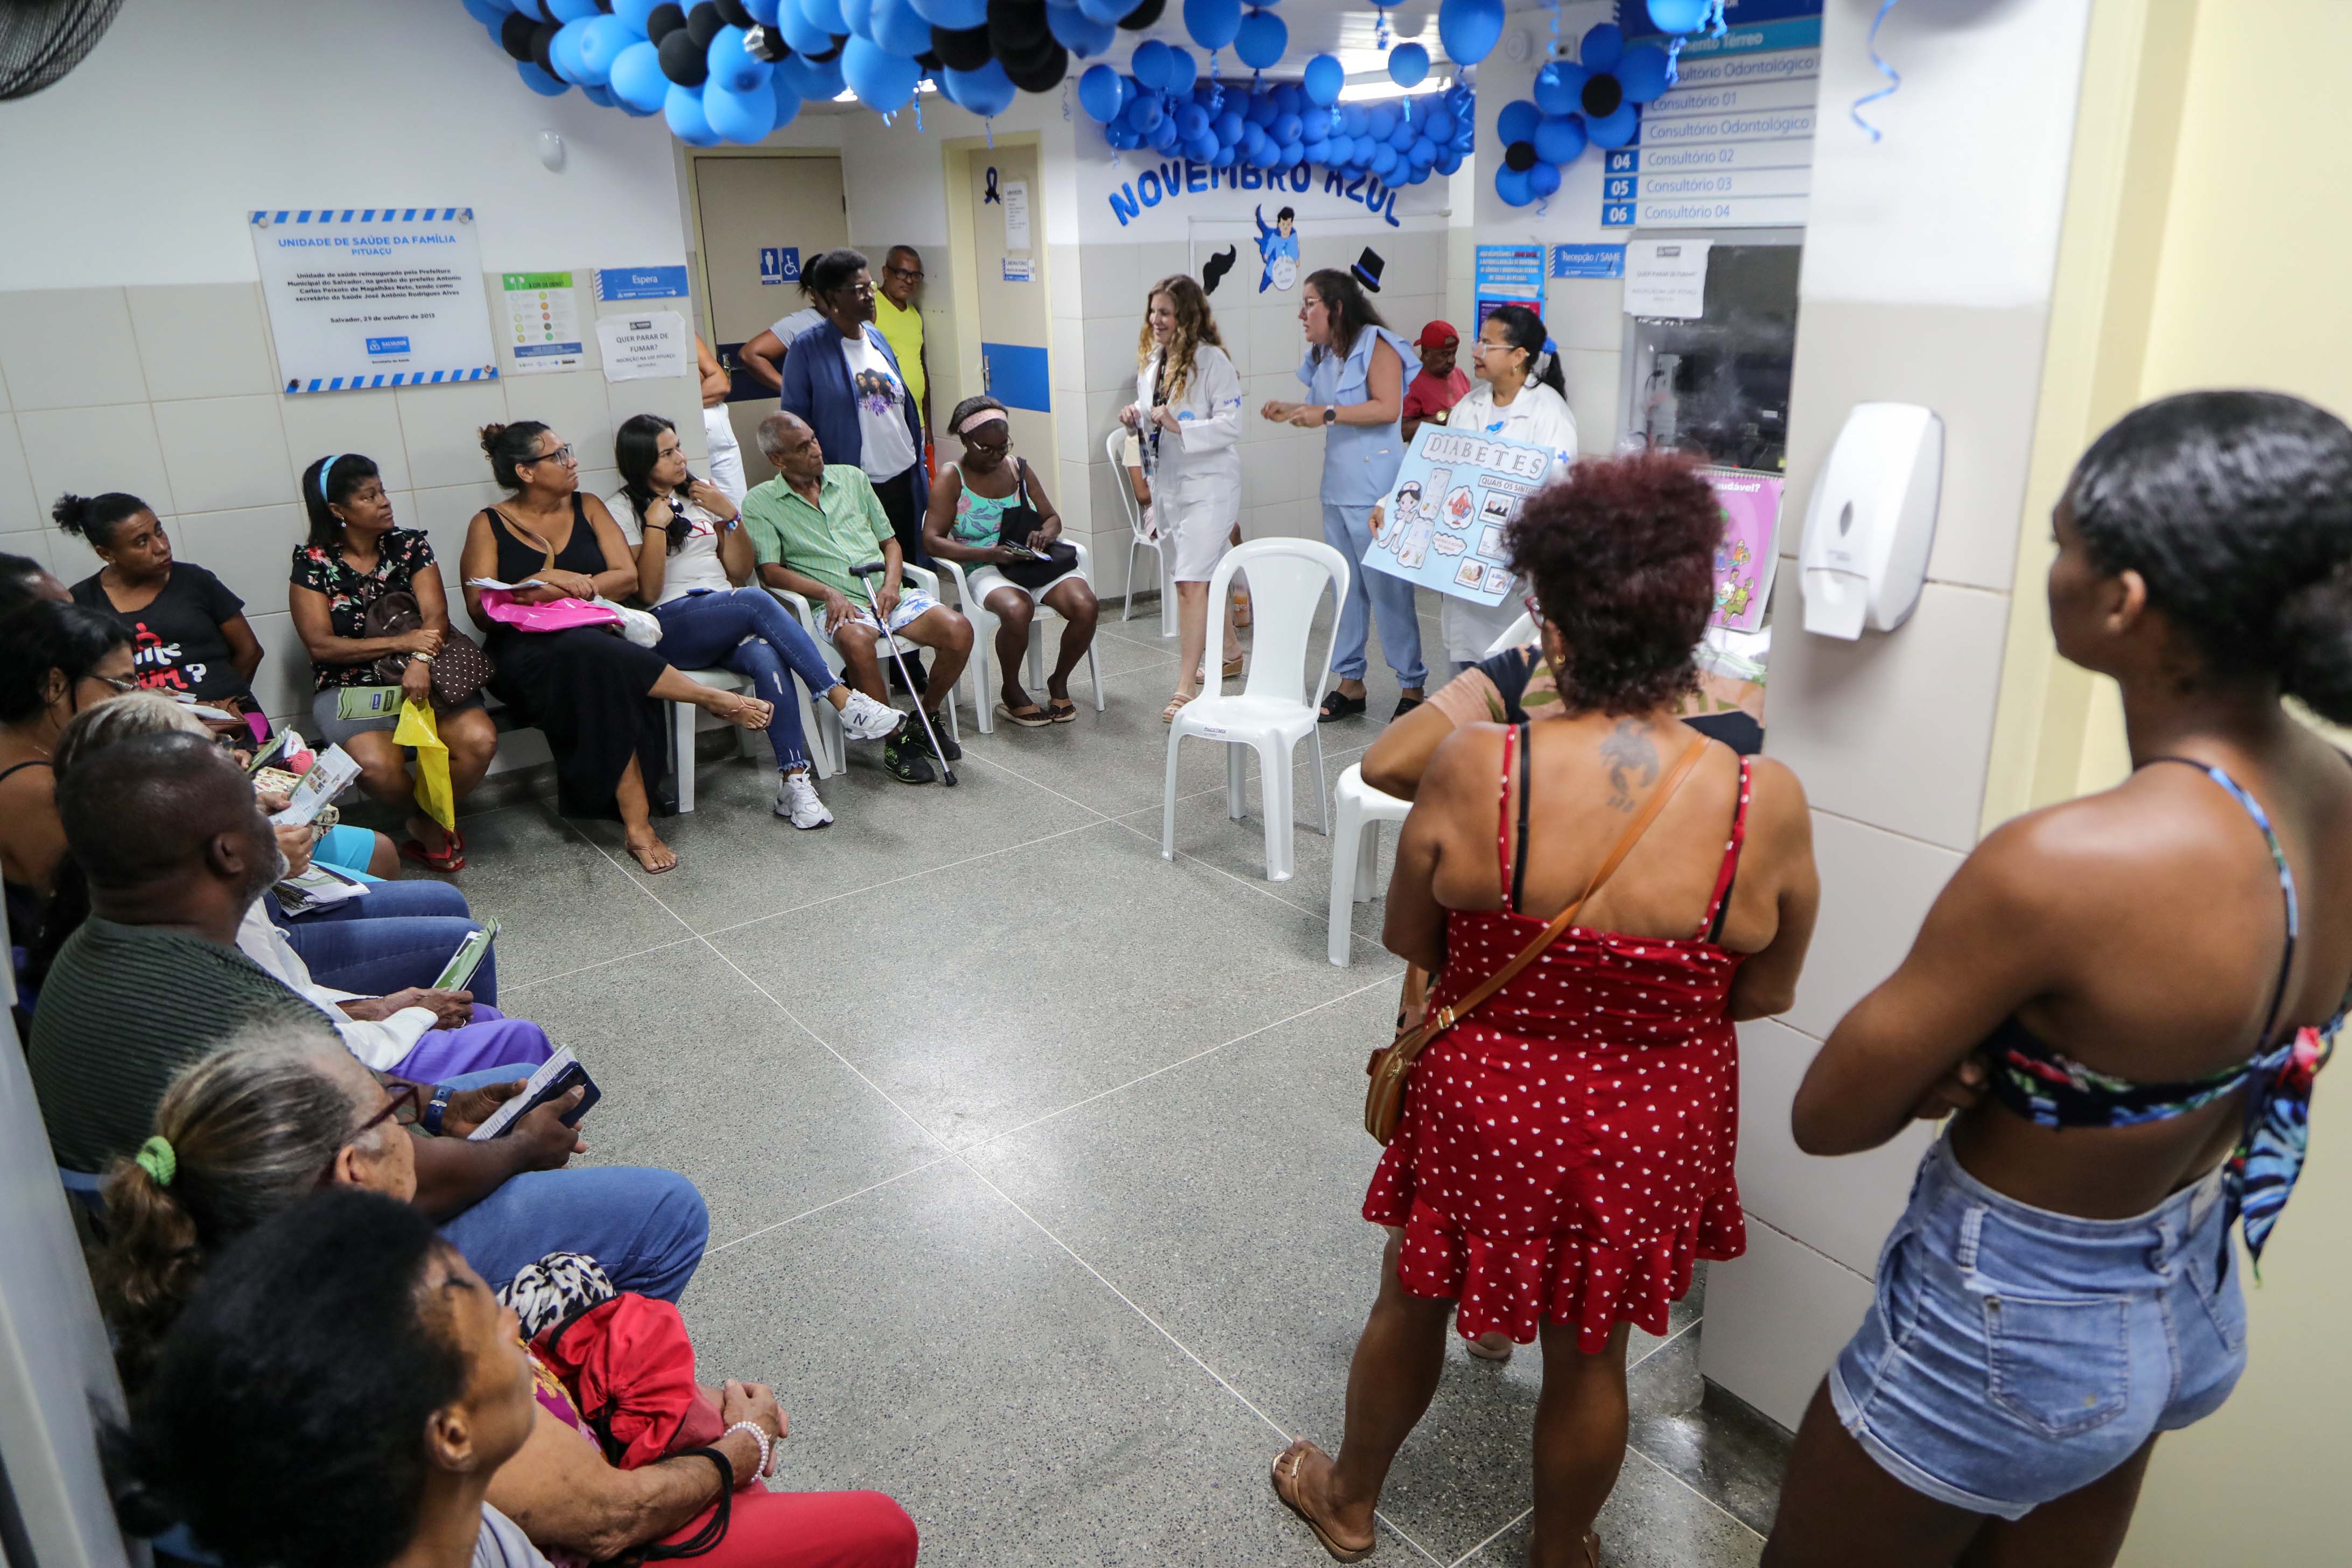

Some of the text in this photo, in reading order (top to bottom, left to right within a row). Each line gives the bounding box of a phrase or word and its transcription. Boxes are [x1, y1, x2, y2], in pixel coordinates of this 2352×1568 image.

[1723, 31, 1763, 48] Térreo
[1677, 66, 1721, 81] sultório
[1725, 58, 1814, 75] Odontológico
[1652, 93, 1737, 111] Consultório 01
[1651, 121, 1717, 139] Consultório
[1721, 116, 1809, 133] Odontológico
[1612, 149, 1735, 170] 04 Consultório 02
[1109, 160, 1400, 227] NOVEMBRO AZUL
[1611, 177, 1732, 196] 05 Consultório 03
[1610, 204, 1731, 222] 06 Consultório 04
[278, 239, 332, 247] UNIDADE
[334, 238, 349, 246] DE
[353, 235, 390, 245] SAÚDE
[412, 234, 457, 243] FAMÍLIA
[1563, 251, 1621, 263] Recepção / SAME
[376, 278, 398, 286] gestão
[410, 276, 435, 284] prefeito
[632, 275, 658, 285] Espera
[360, 284, 395, 292] Magalhães
[409, 290, 440, 298] Rodrigues
[616, 336, 635, 344] QUER
[630, 344, 658, 353] FUMAR?
[1430, 437, 1542, 475] DIABETES
[1482, 477, 1503, 488] QUAIS
